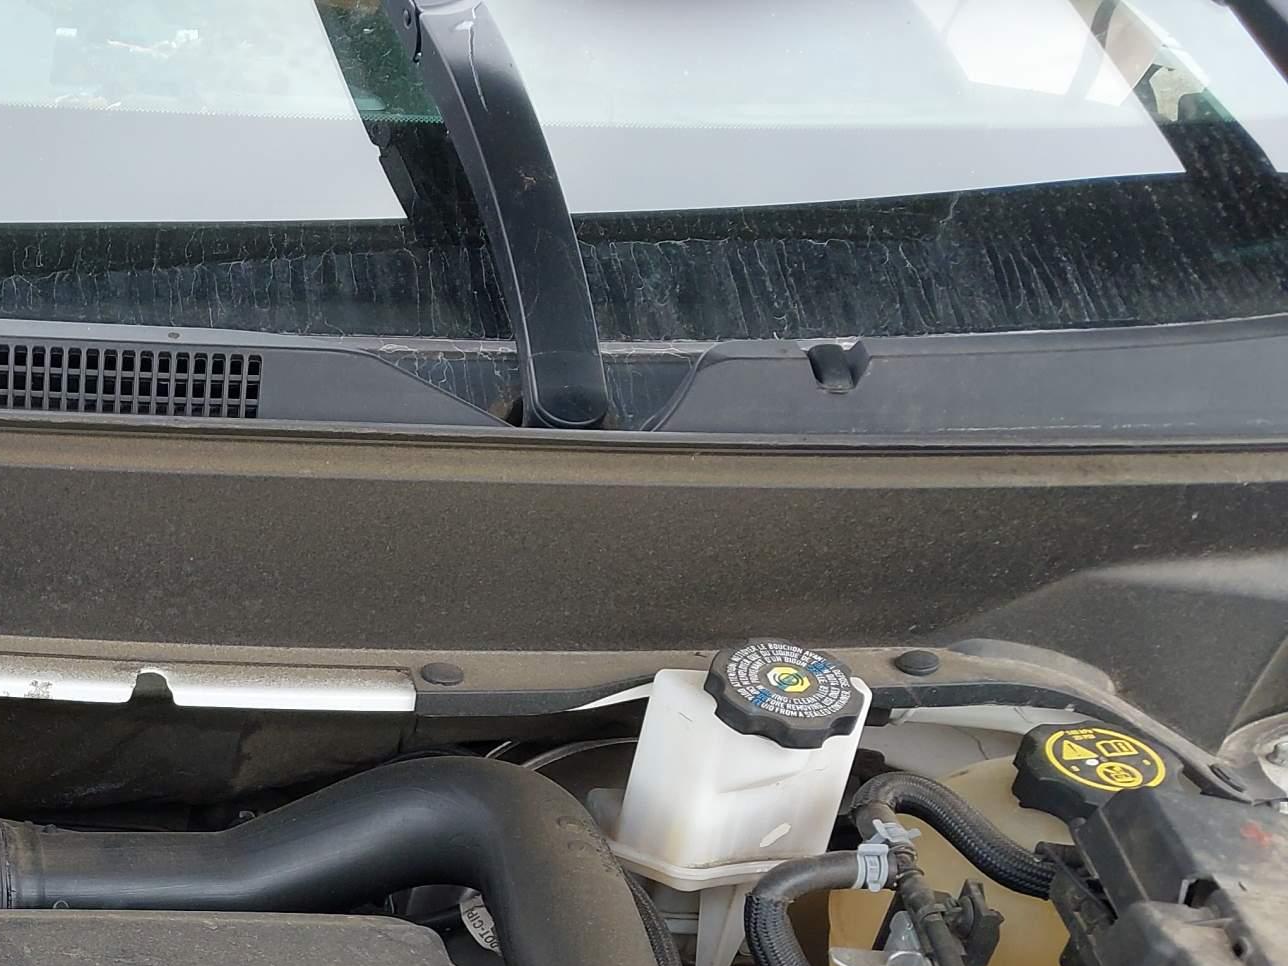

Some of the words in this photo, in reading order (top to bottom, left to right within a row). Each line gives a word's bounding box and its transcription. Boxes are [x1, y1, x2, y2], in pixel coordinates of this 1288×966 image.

[768, 643, 803, 653] BOUCHON
[801, 655, 812, 663] DE
[775, 707, 797, 717] FROM
